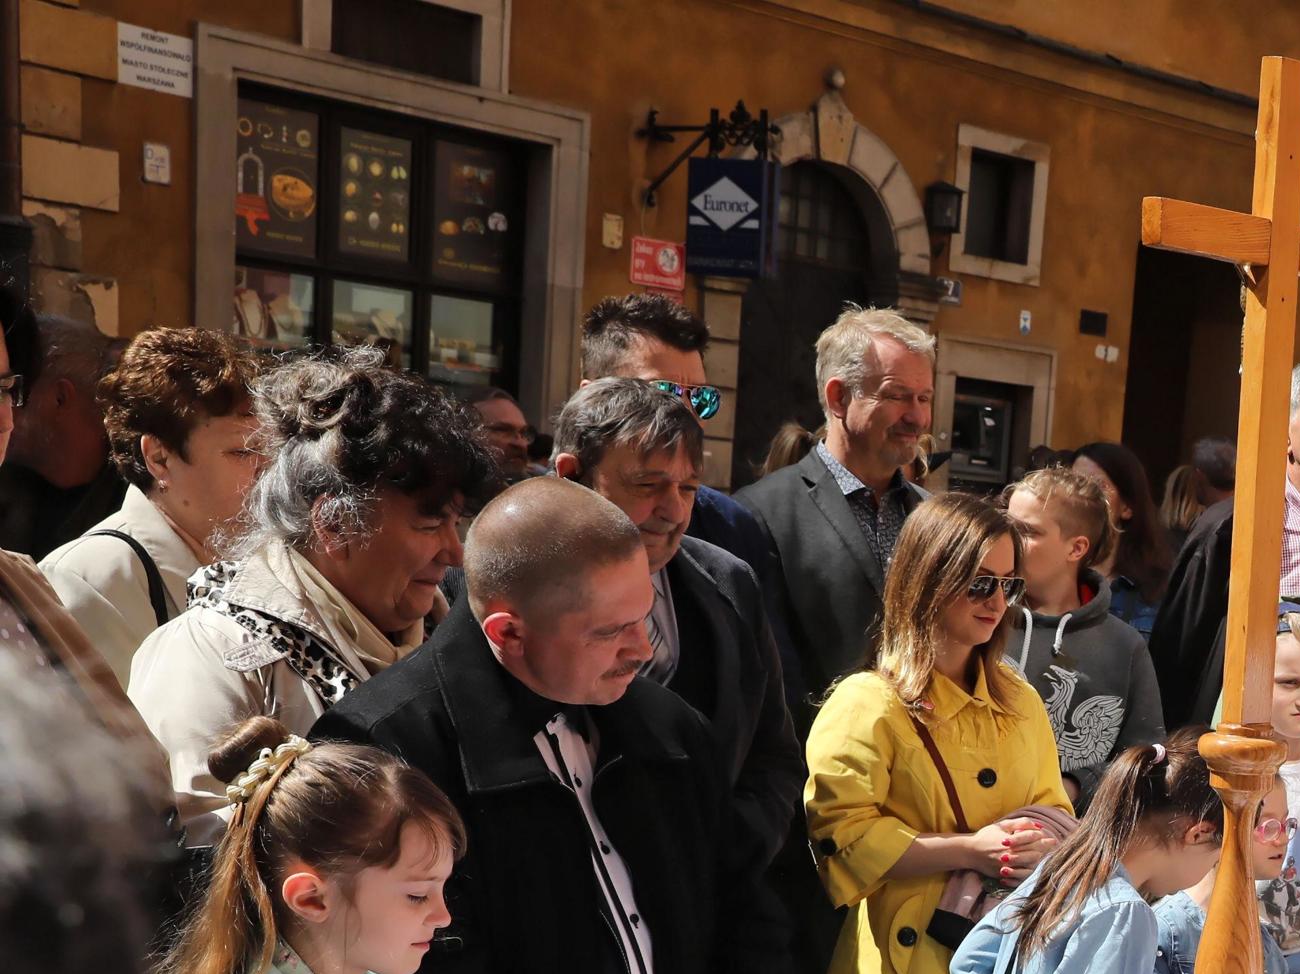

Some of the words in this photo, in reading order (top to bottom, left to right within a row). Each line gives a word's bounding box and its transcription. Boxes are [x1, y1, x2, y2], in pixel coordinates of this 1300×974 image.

[141, 32, 168, 44] REMONT
[122, 58, 148, 70] MIASTO
[136, 75, 175, 88] WARSZAWA
[702, 194, 749, 213] Euronet
